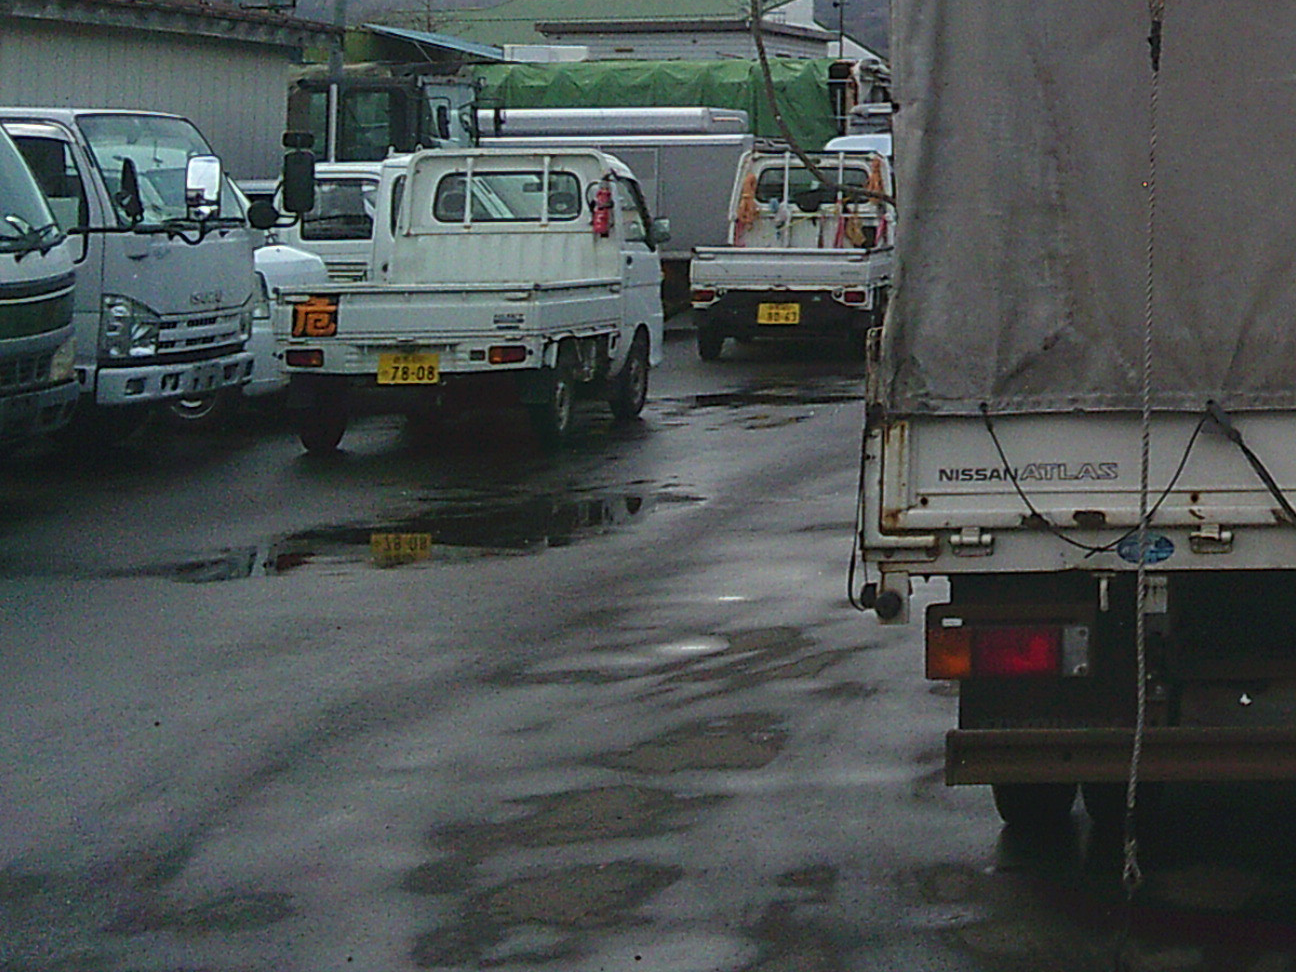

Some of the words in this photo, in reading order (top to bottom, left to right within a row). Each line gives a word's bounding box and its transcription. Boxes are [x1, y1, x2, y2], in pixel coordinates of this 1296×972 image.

[292, 295, 337, 337] 危
[391, 365, 436, 382] 78-08
[939, 468, 1018, 482] NISSAN
[1020, 462, 1119, 481] ATLAS
